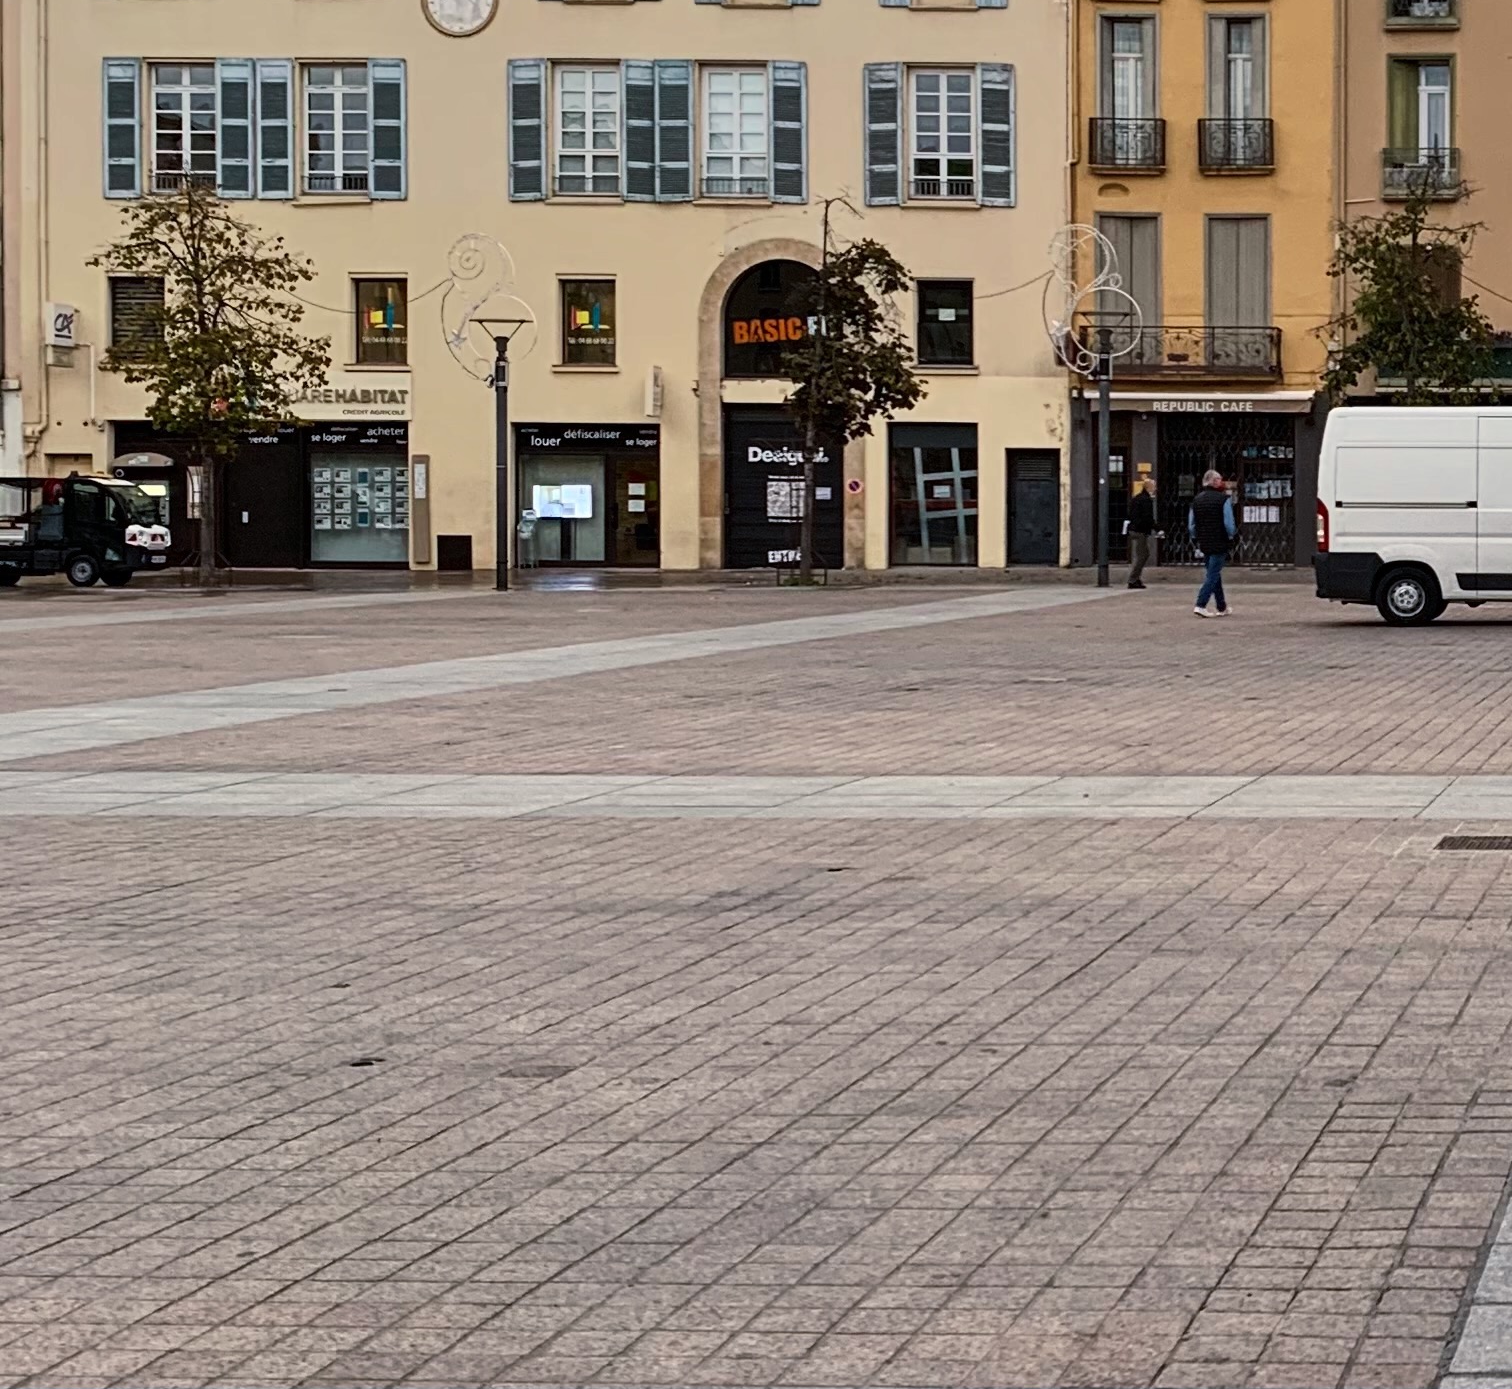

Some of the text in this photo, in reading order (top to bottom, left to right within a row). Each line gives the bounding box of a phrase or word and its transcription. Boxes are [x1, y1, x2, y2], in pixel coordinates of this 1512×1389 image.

[1153, 401, 1215, 412] REPUBLIC
[367, 426, 405, 436] acheter
[564, 429, 621, 439] défiscaliser
[311, 433, 346, 443] se loger
[531, 435, 561, 446] louer
[636, 438, 657, 447] loger
